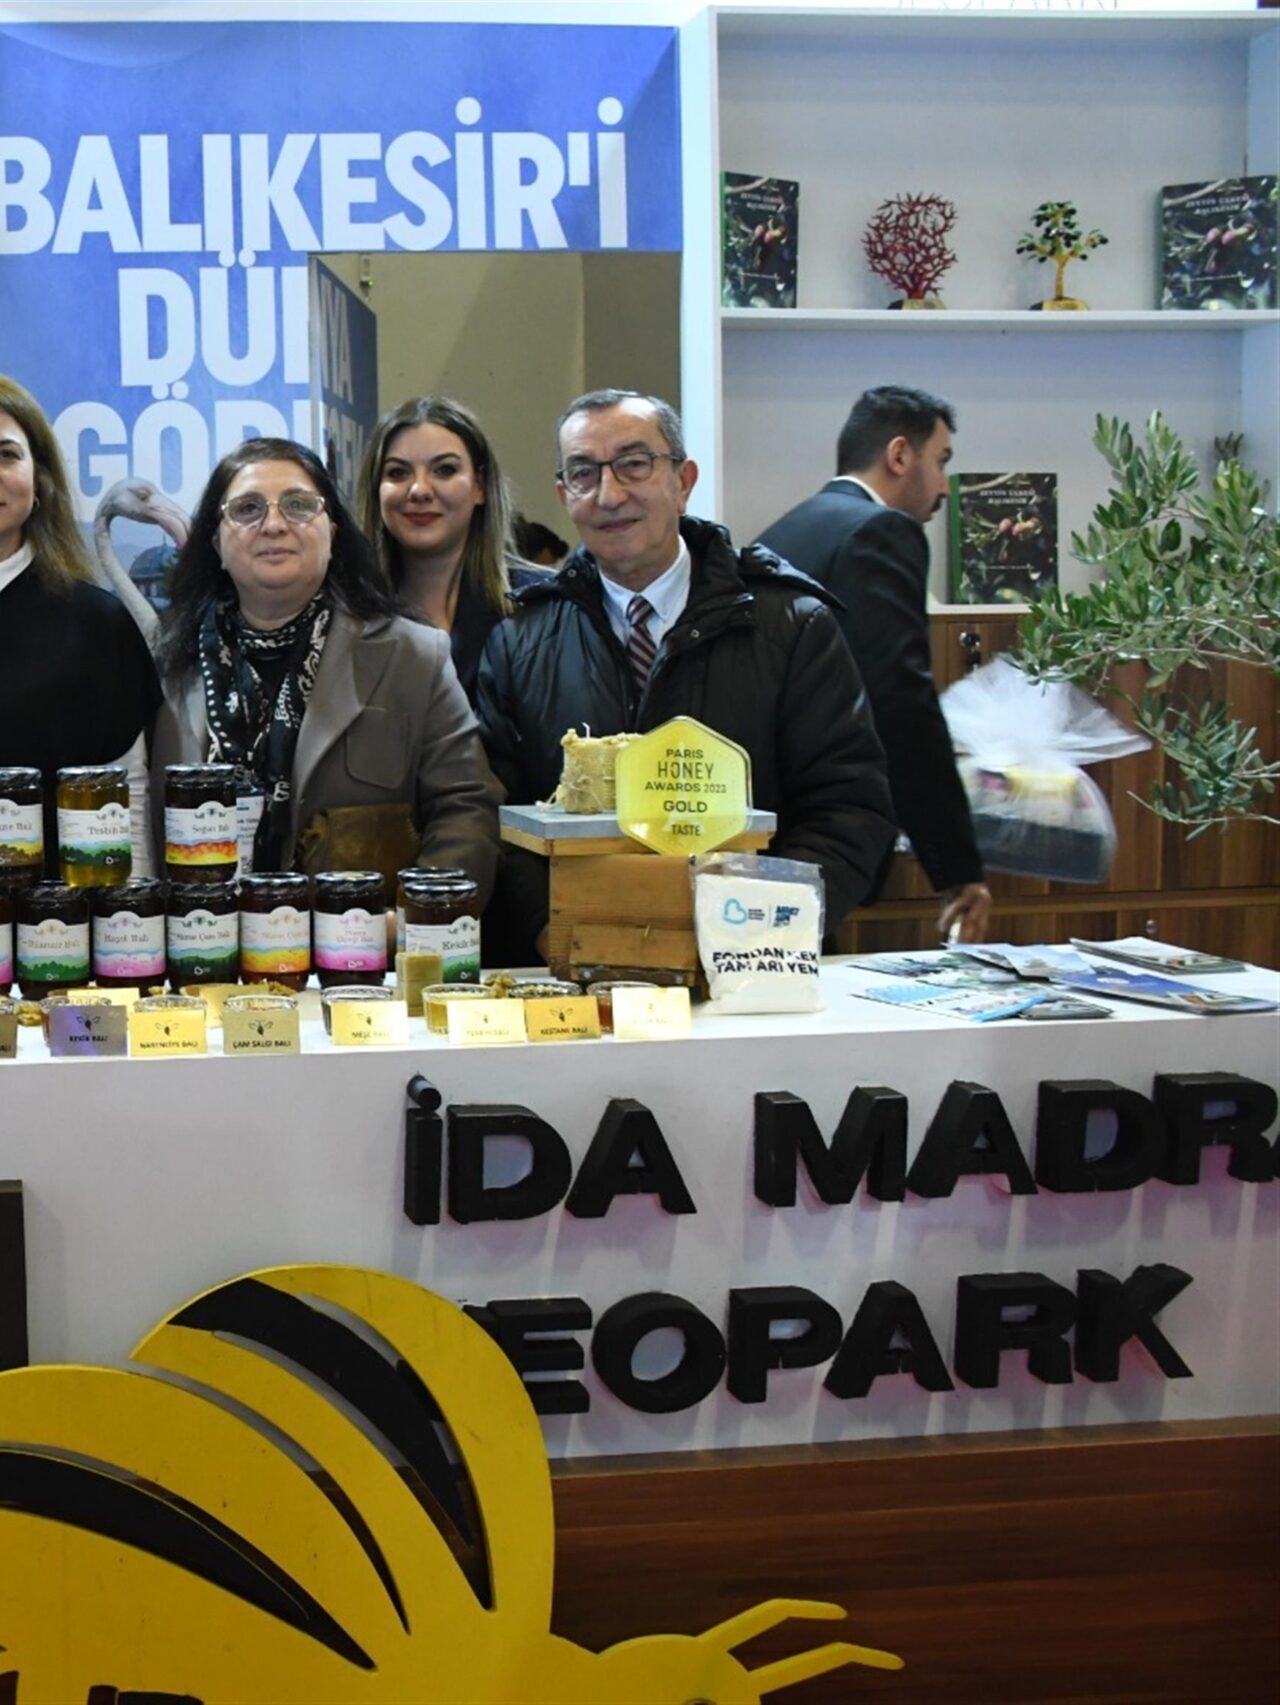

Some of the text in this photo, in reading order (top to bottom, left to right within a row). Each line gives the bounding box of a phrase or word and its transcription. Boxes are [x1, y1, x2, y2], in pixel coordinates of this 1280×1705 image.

[666, 749, 704, 759] PARIS
[658, 761, 714, 779] HONEY
[644, 782, 701, 792] AWARDS
[663, 800, 708, 813] GOLD
[671, 824, 701, 836] TASTE
[757, 961, 784, 973] ARI
[233, 1041, 250, 1049] ÇAM
[404, 1071, 1280, 1225] İDA MADR
[461, 1263, 1195, 1415] EOPARK
